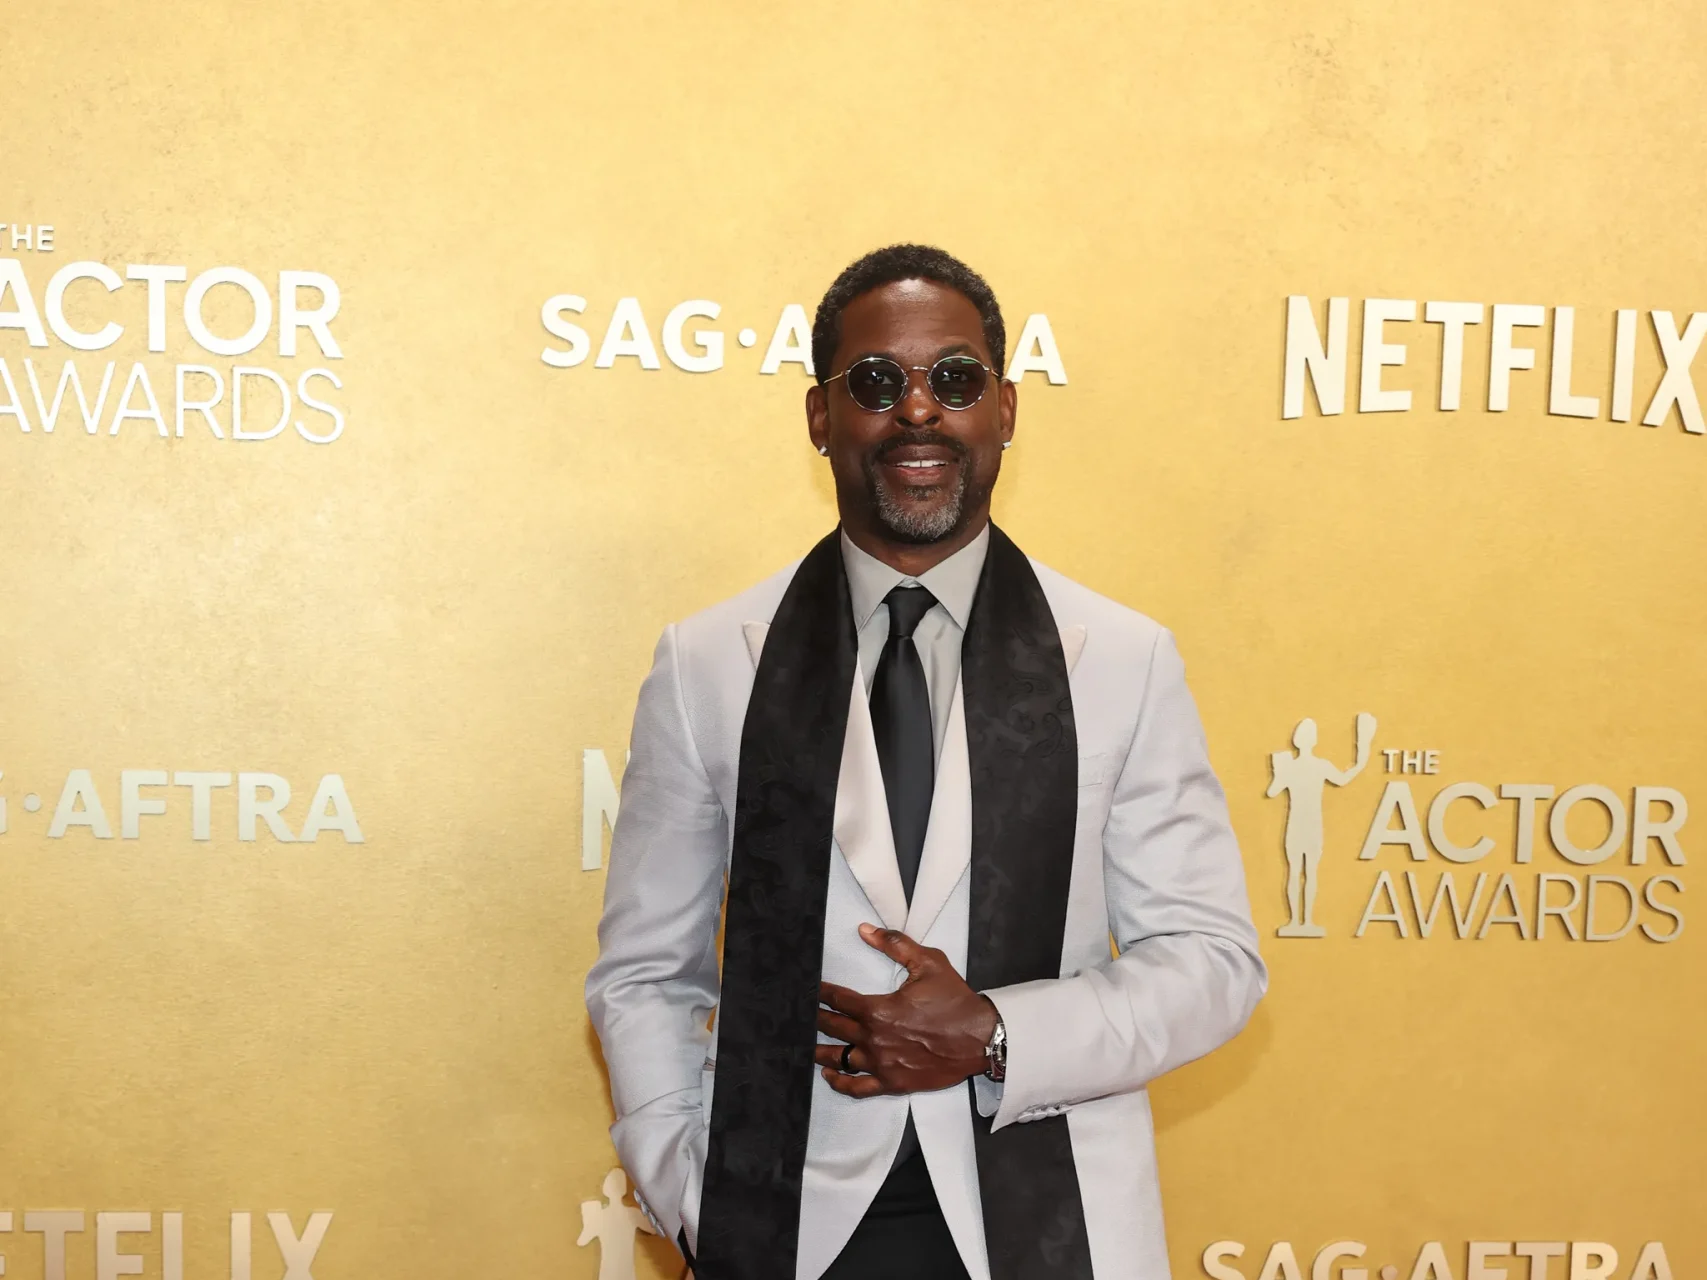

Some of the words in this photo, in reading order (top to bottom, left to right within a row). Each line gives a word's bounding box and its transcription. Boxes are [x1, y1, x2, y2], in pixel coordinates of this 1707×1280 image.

[0, 258, 344, 359] ACTOR
[540, 294, 1068, 386] SAG·AA
[1281, 295, 1707, 435] NETFLIX
[1382, 748, 1441, 775] THE
[0, 768, 365, 844] ·AFTRA
[1357, 781, 1689, 866] ACTOR
[1355, 870, 1686, 943] AWARDS
